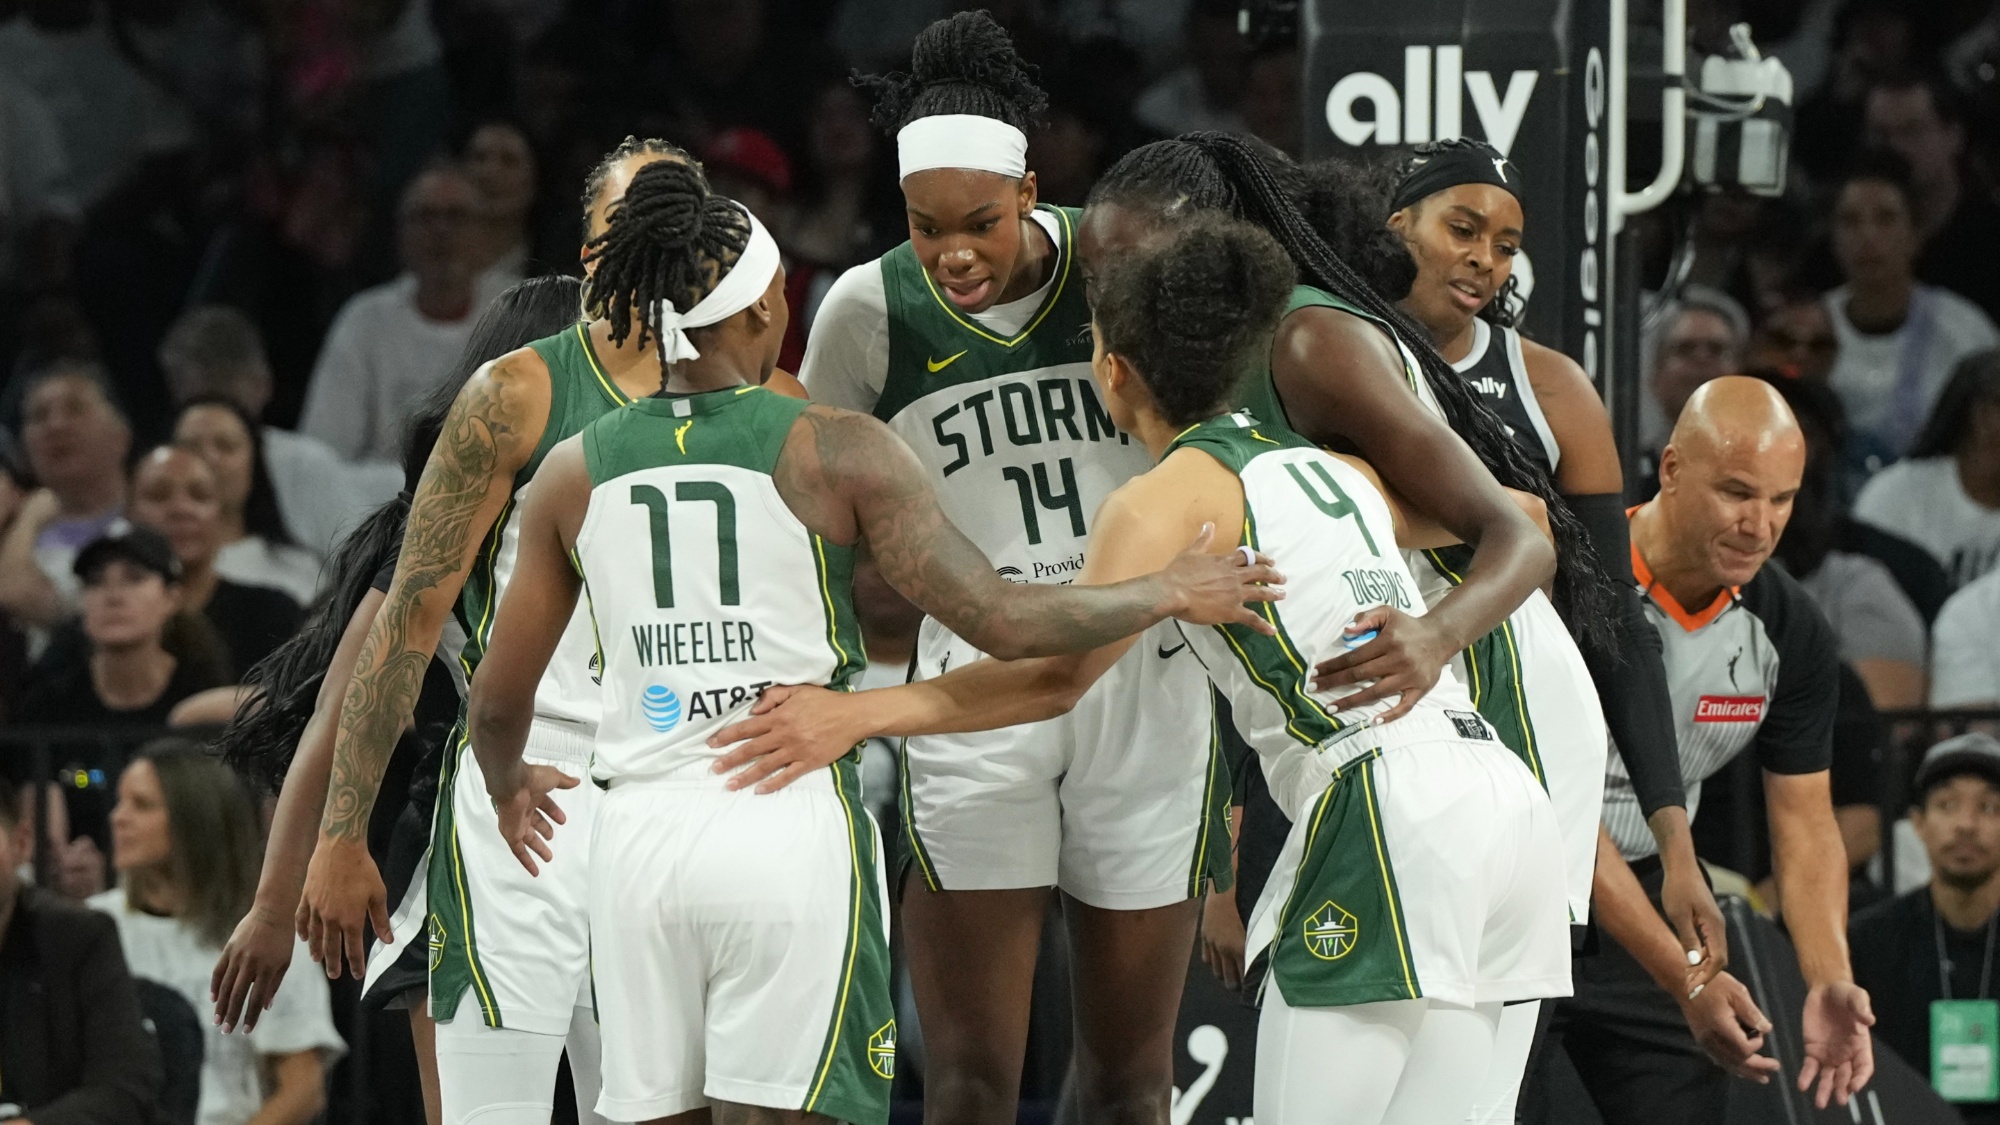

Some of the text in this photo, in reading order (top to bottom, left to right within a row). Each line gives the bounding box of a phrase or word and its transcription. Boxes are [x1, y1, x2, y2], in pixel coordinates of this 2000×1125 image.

[1326, 45, 1539, 158] ally
[1065, 336, 1091, 347] SYME
[1002, 457, 1087, 545] 14
[1282, 461, 1381, 557] 4
[630, 481, 740, 608] 17
[1032, 553, 1085, 578] Provid
[1341, 568, 1411, 609] DIGGINS
[632, 621, 757, 667] WHEELER
[1697, 700, 1761, 716] Emirates
